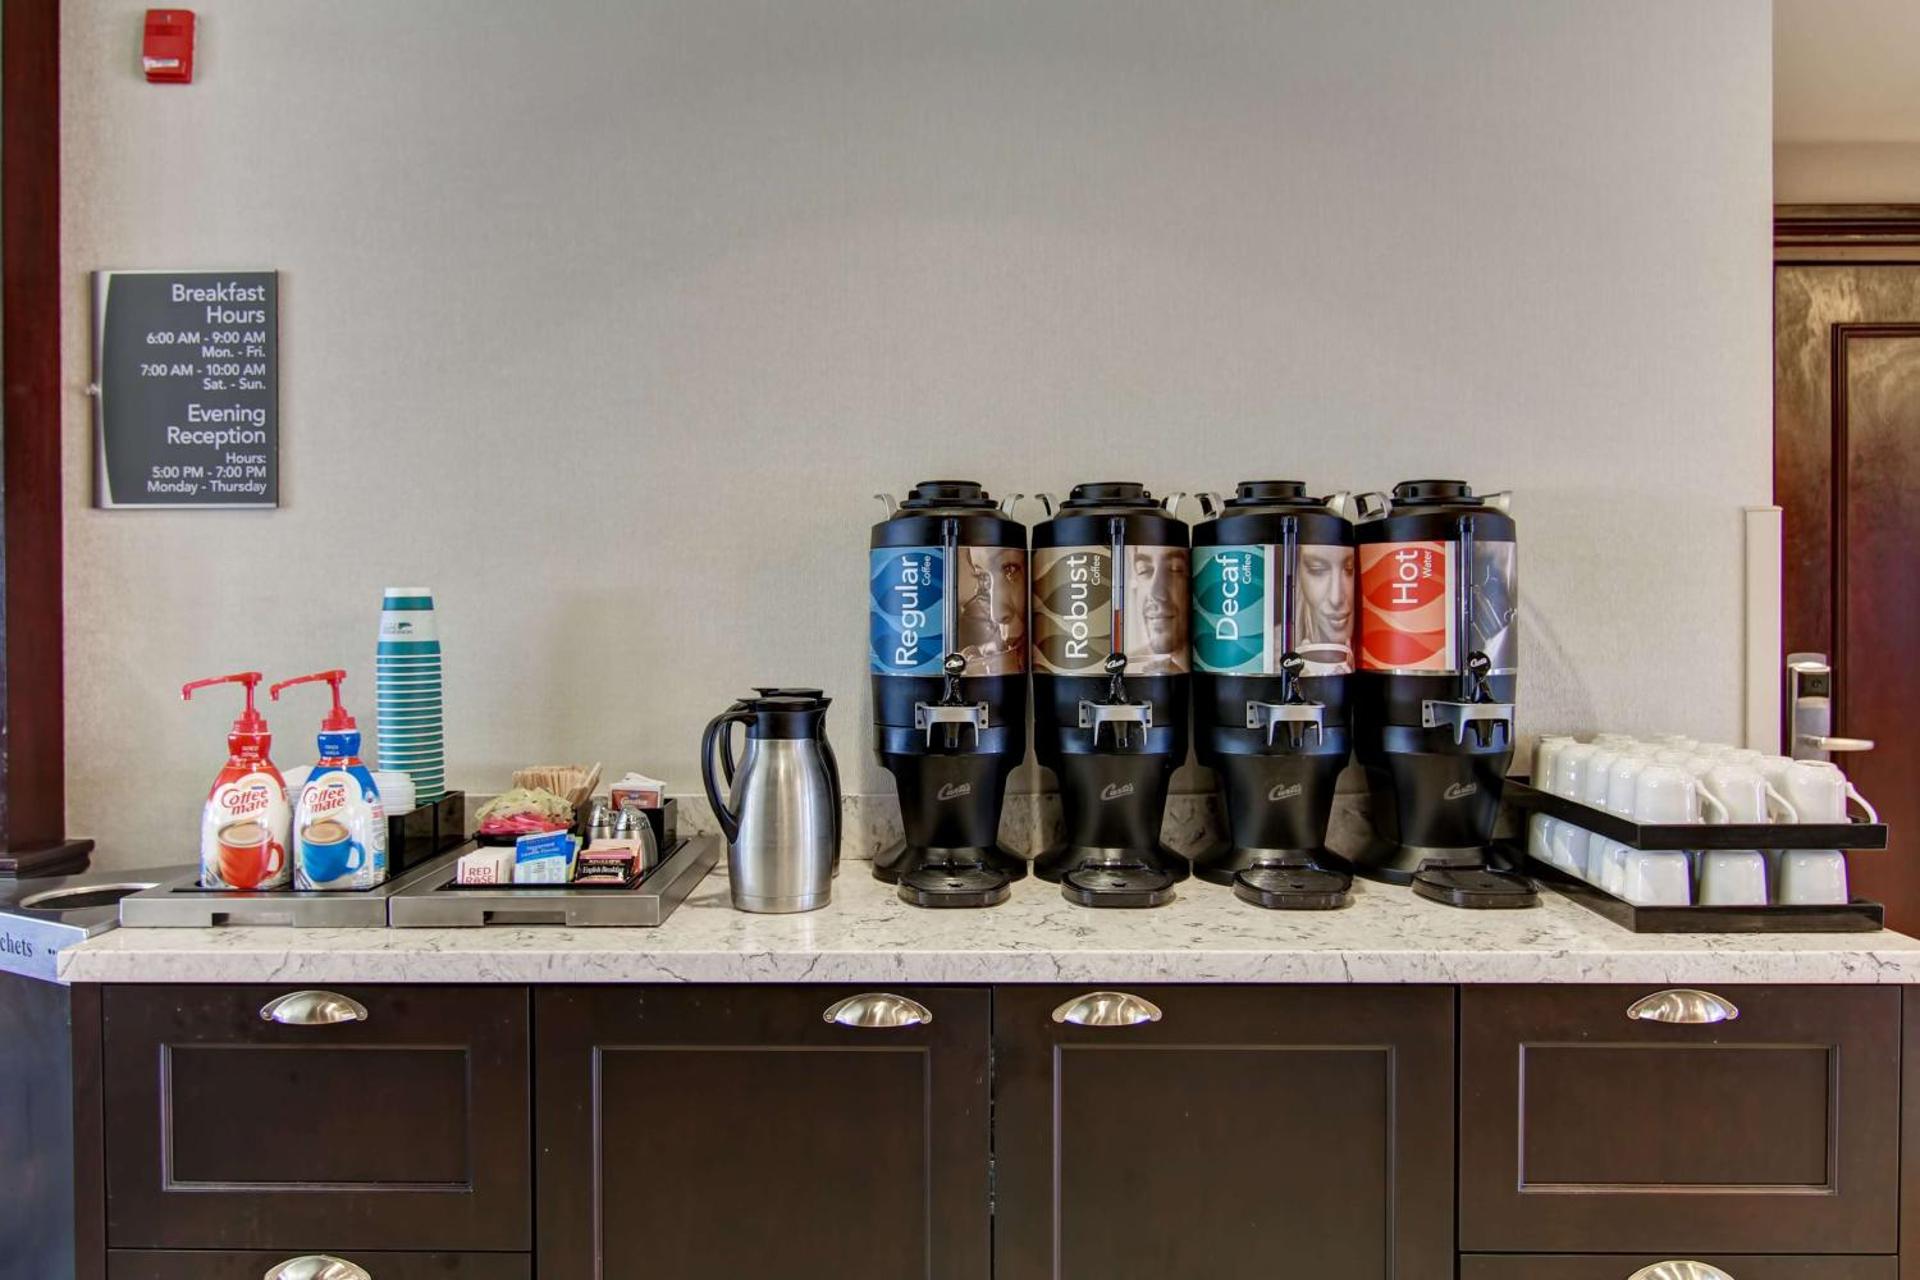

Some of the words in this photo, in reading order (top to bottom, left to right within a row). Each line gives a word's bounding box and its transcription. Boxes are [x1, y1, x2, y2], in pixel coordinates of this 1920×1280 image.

[172, 282, 266, 302] Breakfast
[207, 305, 266, 324] Hours
[146, 332, 174, 344] 6:00
[177, 332, 200, 344] AM
[212, 332, 240, 344] 9:00
[243, 332, 266, 344] AM
[201, 346, 234, 357] Mon.
[246, 346, 266, 357] Fri.
[140, 364, 167, 376] 7:00
[170, 364, 193, 376] AM
[207, 364, 240, 376] 10:00
[243, 364, 266, 376] AM
[203, 378, 227, 390] Sat.
[239, 378, 266, 390] Sun.
[188, 404, 266, 427] Evening
[167, 426, 266, 449] Reception
[226, 452, 267, 464] Hours:
[152, 467, 180, 478] 5:00
[183, 467, 204, 478] PM
[216, 467, 243, 478] 7:00
[246, 467, 266, 478] PM
[147, 481, 197, 495] Monday
[210, 481, 267, 495] Thursday
[921, 555, 931, 586] Coffee
[1091, 555, 1100, 586] Coffee
[1243, 553, 1252, 585] Coffee
[1422, 551, 1432, 578] Water
[1392, 550, 1418, 604] Hot
[1063, 555, 1088, 658] Robust
[1215, 554, 1239, 640] Decaf
[895, 556, 926, 665] Regular
[221, 788, 268, 809] Coffee
[303, 786, 345, 806] Coffee
[311, 797, 345, 813] mate
[231, 799, 269, 815] mate
[469, 867, 491, 875] RED
